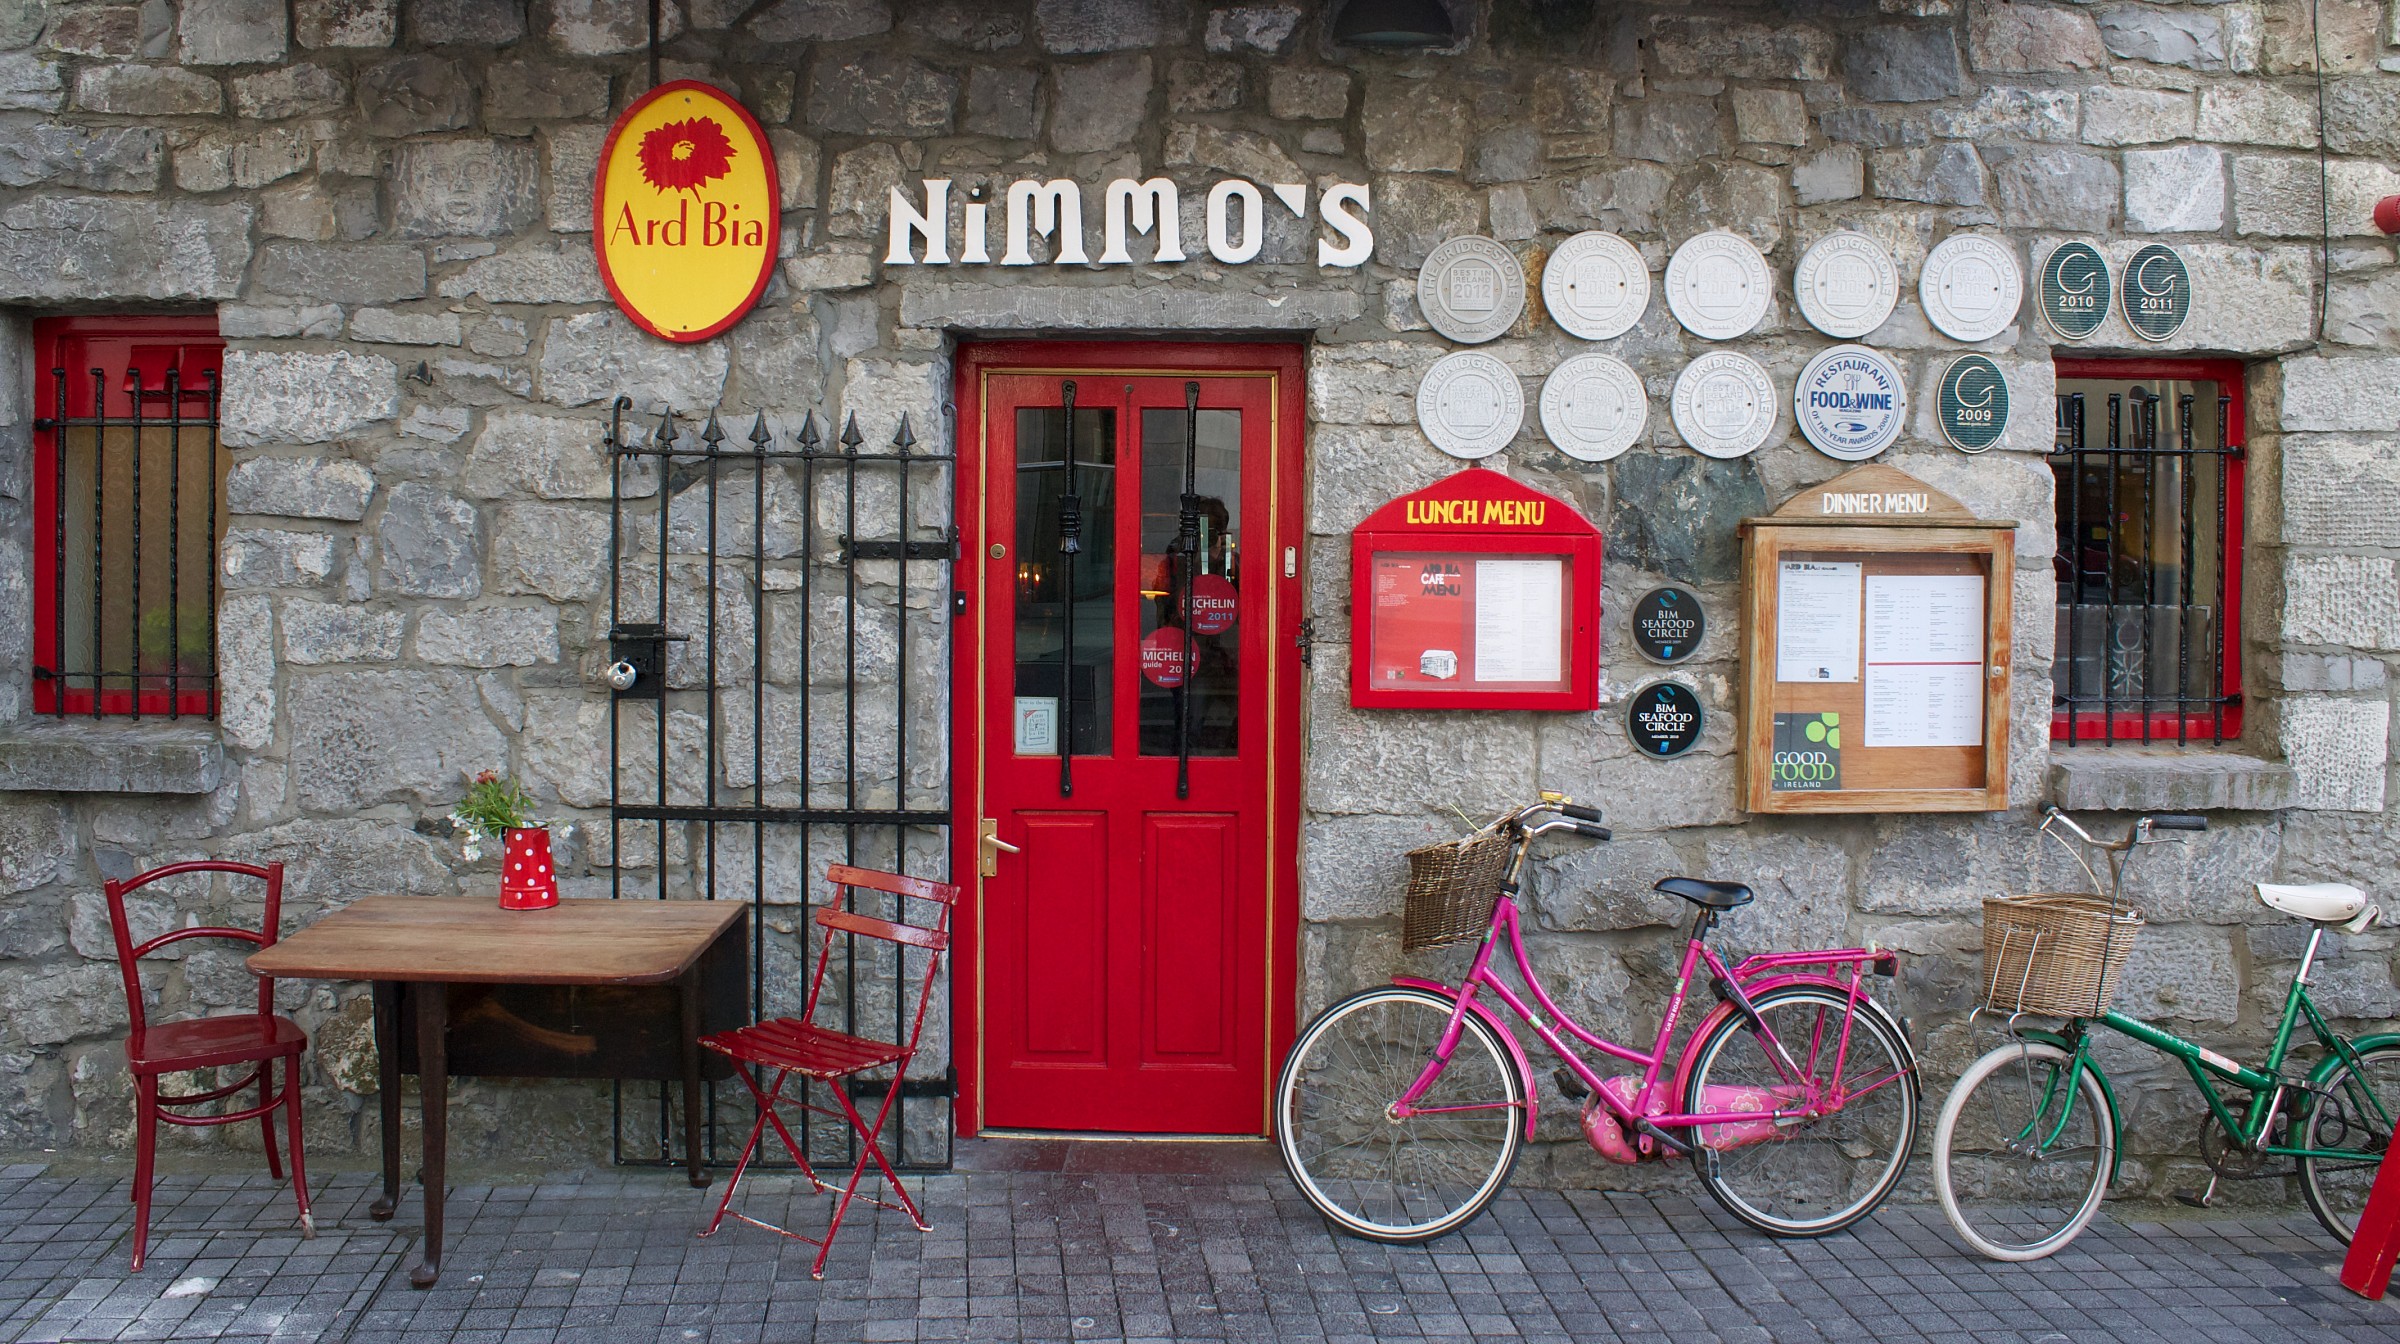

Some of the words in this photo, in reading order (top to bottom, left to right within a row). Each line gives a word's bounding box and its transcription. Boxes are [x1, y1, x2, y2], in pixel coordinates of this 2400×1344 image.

[610, 199, 688, 246] Ard
[702, 201, 763, 246] Bia
[1422, 267, 1439, 300] THE
[1434, 242, 1520, 298] BRIDGESTONE
[1453, 269, 1477, 277] BEST
[1548, 262, 1563, 296] THE
[1560, 239, 1645, 296] BRIDGESTONE
[1671, 262, 1687, 296] THE
[1682, 238, 1767, 295] BRIDGESTONE
[1799, 263, 1816, 294] THE
[1812, 238, 1893, 297] BRIDGESTONE
[1925, 263, 1942, 297] THE
[1937, 240, 2017, 300] BRIDGESTONE
[1578, 272, 1616, 280] IRELAND
[1454, 284, 1491, 298] 2012
[1701, 280, 1738, 294] 2007
[2058, 295, 2094, 308] 2010
[2140, 297, 2173, 310] 2011
[1815, 360, 1891, 391] RESTAURANT
[1422, 380, 1439, 415] THE
[1434, 357, 1519, 415] BRIDGESTONE
[1545, 380, 1563, 414] THE
[1560, 361, 1641, 422] BRIDGESTONE
[1677, 382, 1693, 416] THE
[1688, 357, 1772, 414] BRIDGESTONE
[1705, 384, 1730, 392] BEST
[1733, 384, 1744, 392] IN
[1705, 391, 1744, 399] IRELAND
[1956, 409, 1992, 421] 2009
[1811, 410, 1821, 420] OF
[1816, 421, 1830, 434] THE
[1828, 433, 1847, 445] YEAR
[1847, 429, 1879, 445] AWARDS
[1877, 413, 1890, 431] 2006
[1822, 492, 1882, 514] DINNER
[1884, 493, 1928, 514] MENU
[1406, 500, 1478, 525] LUNCH
[1482, 500, 1546, 526] MENU
[1420, 573, 1445, 585] CAFE
[1421, 584, 1461, 596] MENU
[1182, 598, 1235, 609] ICHELIN
[1207, 612, 1233, 621] 2011
[1658, 610, 1679, 619] BIM
[1641, 619, 1695, 629] SEAFOOD
[1647, 628, 1689, 638] CIRCLE
[1142, 651, 1196, 662] MICHELN
[1142, 661, 1163, 669] guide
[1168, 665, 1196, 674] 202
[1655, 703, 1677, 713] BIM
[1638, 712, 1693, 722] SEAFOOD
[1645, 722, 1686, 732] CIRCLE
[1774, 751, 1827, 765] GOOD
[1771, 762, 1836, 781] FOOD
[1665, 1022, 1672, 1032] ON
[1671, 996, 1681, 1013] ROAD
[1558, 1042, 1572, 1056] ROAD
